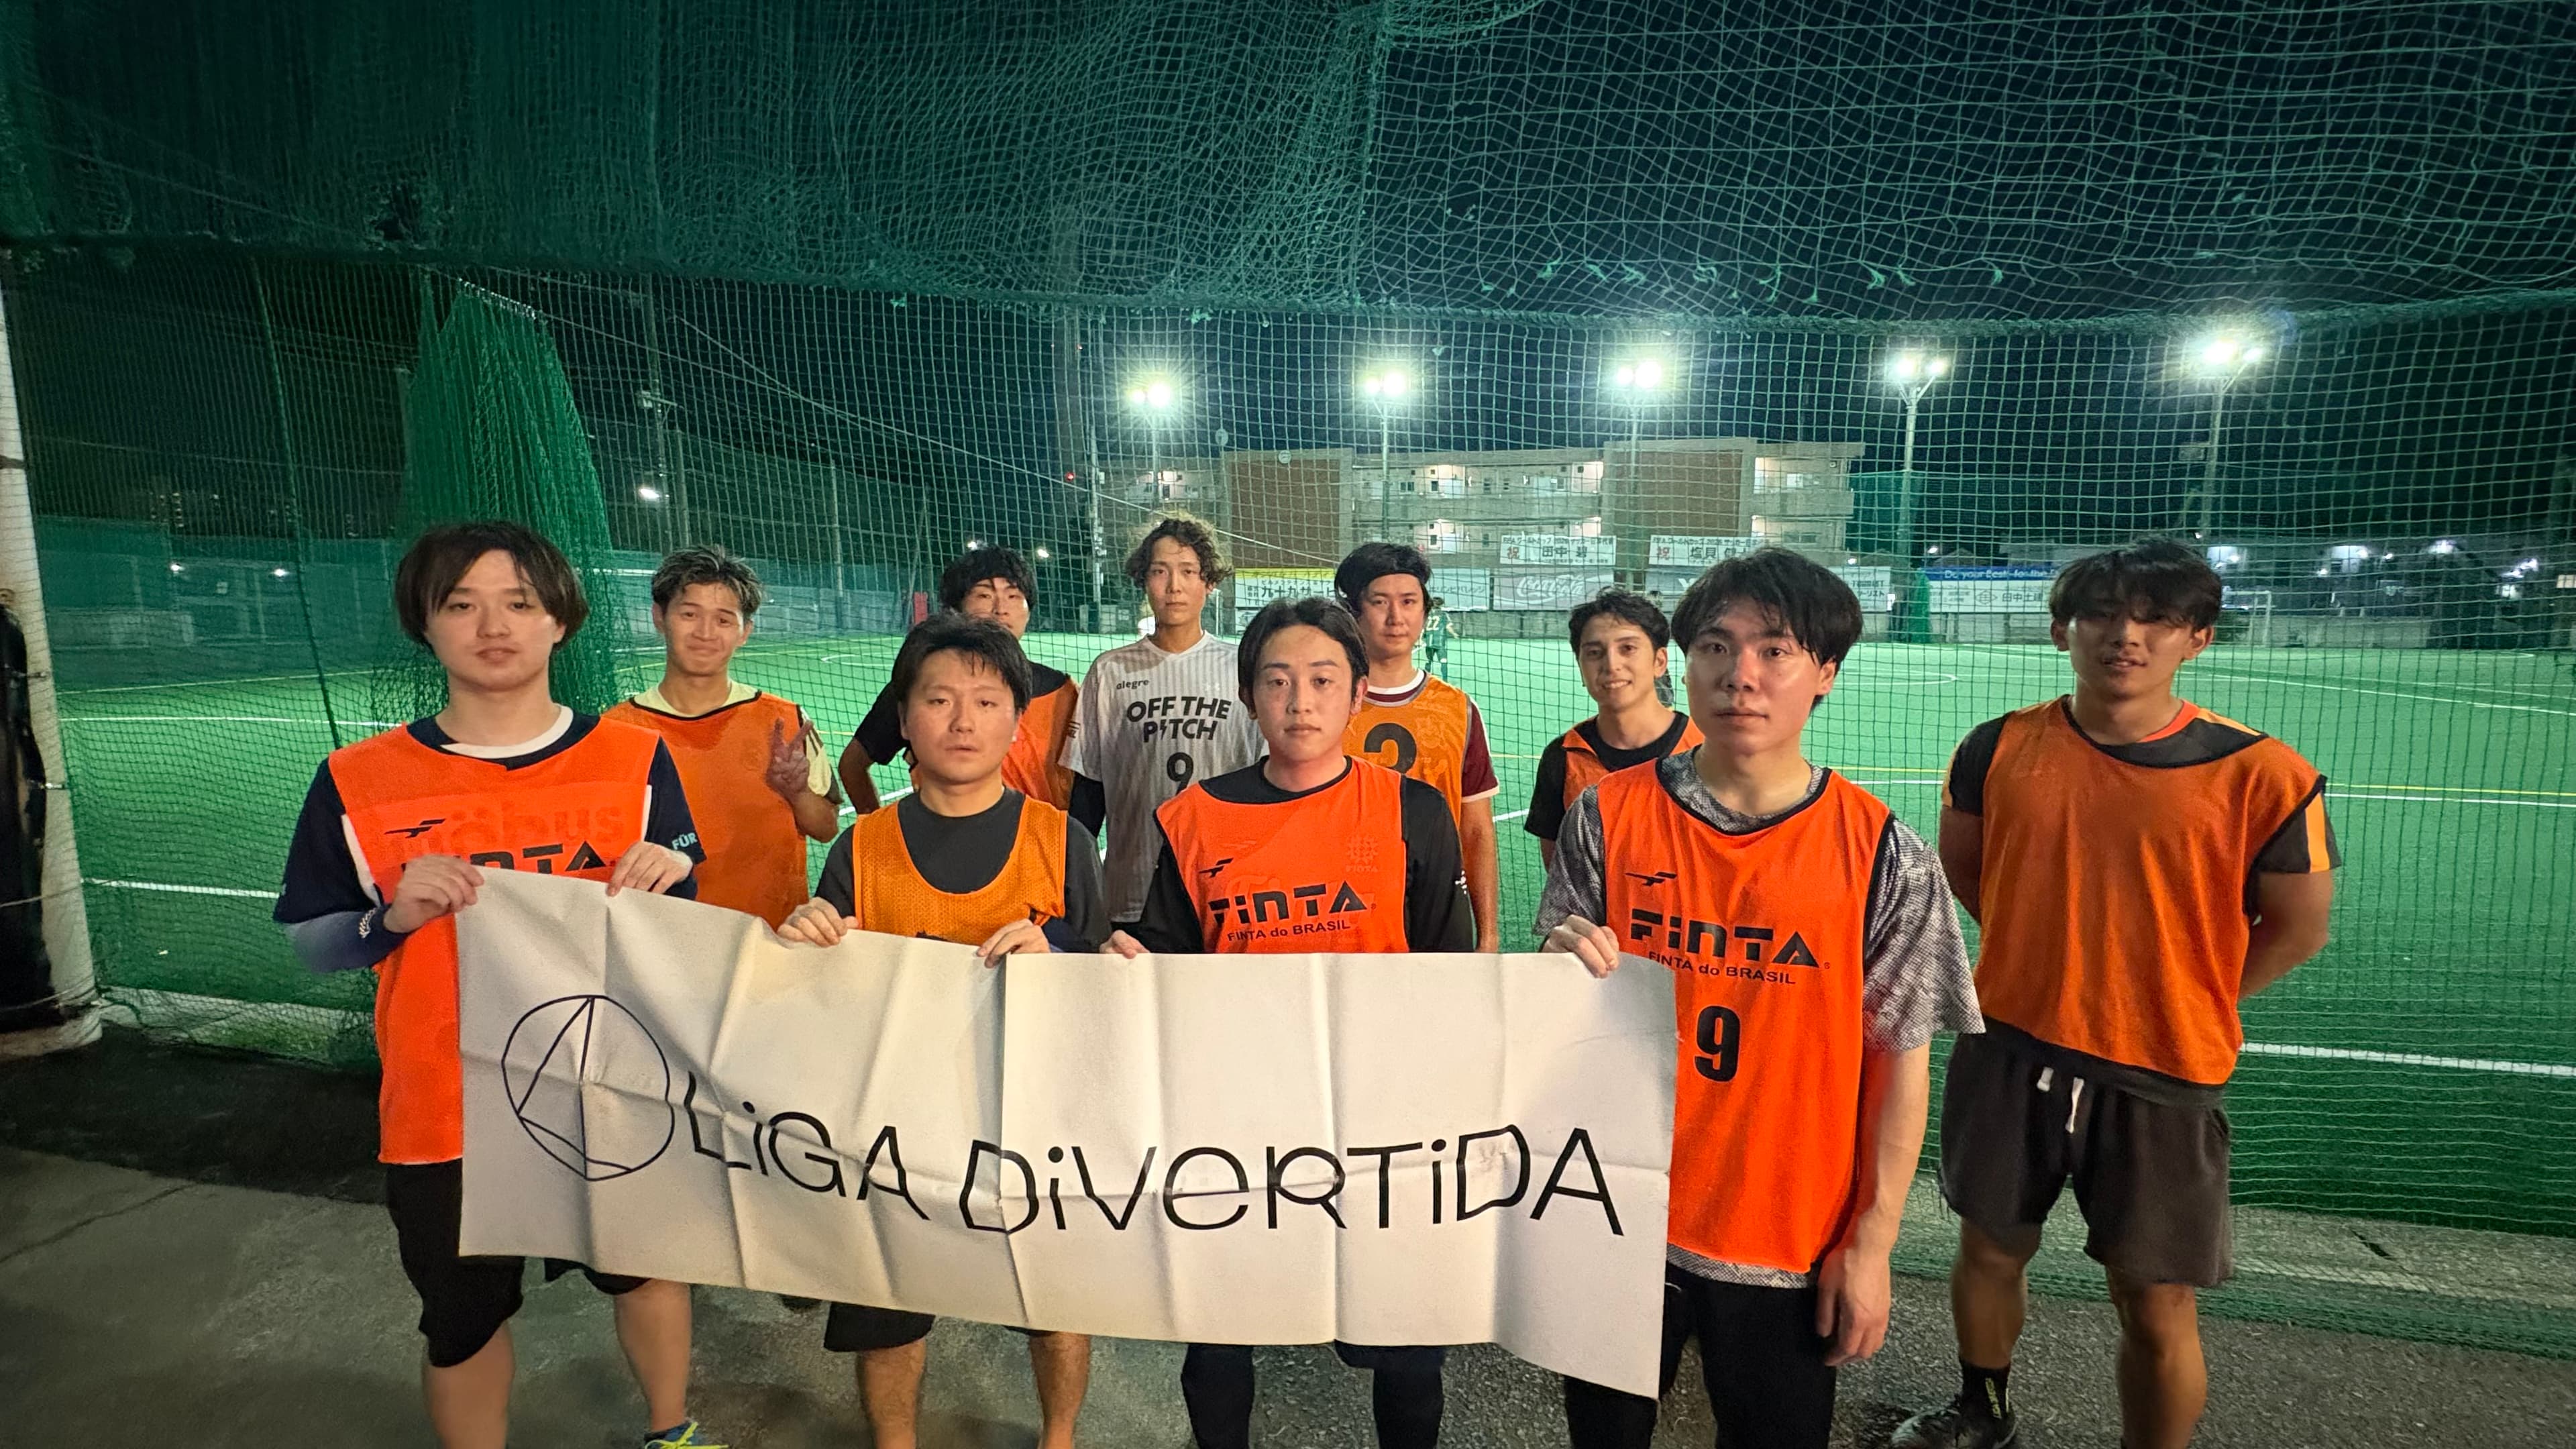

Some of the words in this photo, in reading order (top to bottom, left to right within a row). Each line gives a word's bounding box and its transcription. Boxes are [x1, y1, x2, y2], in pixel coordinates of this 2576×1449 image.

[1507, 546, 1519, 559] 祝
[1657, 546, 1670, 561] 祝
[1944, 570, 1959, 578] Do
[1962, 572, 1984, 580] your
[1426, 615, 1440, 631] 22
[1116, 678, 1150, 690] alegre
[1126, 696, 1177, 723] OFF
[1181, 696, 1232, 720] THE
[1166, 751, 1194, 797] 9
[672, 832, 698, 851] FÜR
[1227, 928, 1267, 942] FINTA
[1270, 926, 1289, 937] do
[1292, 919, 1351, 936] BRASIL
[1648, 951, 1695, 972] FINTA
[1698, 963, 1721, 977] do
[1725, 966, 1796, 985] BRASIL
[1694, 1005, 1741, 1083] 9
